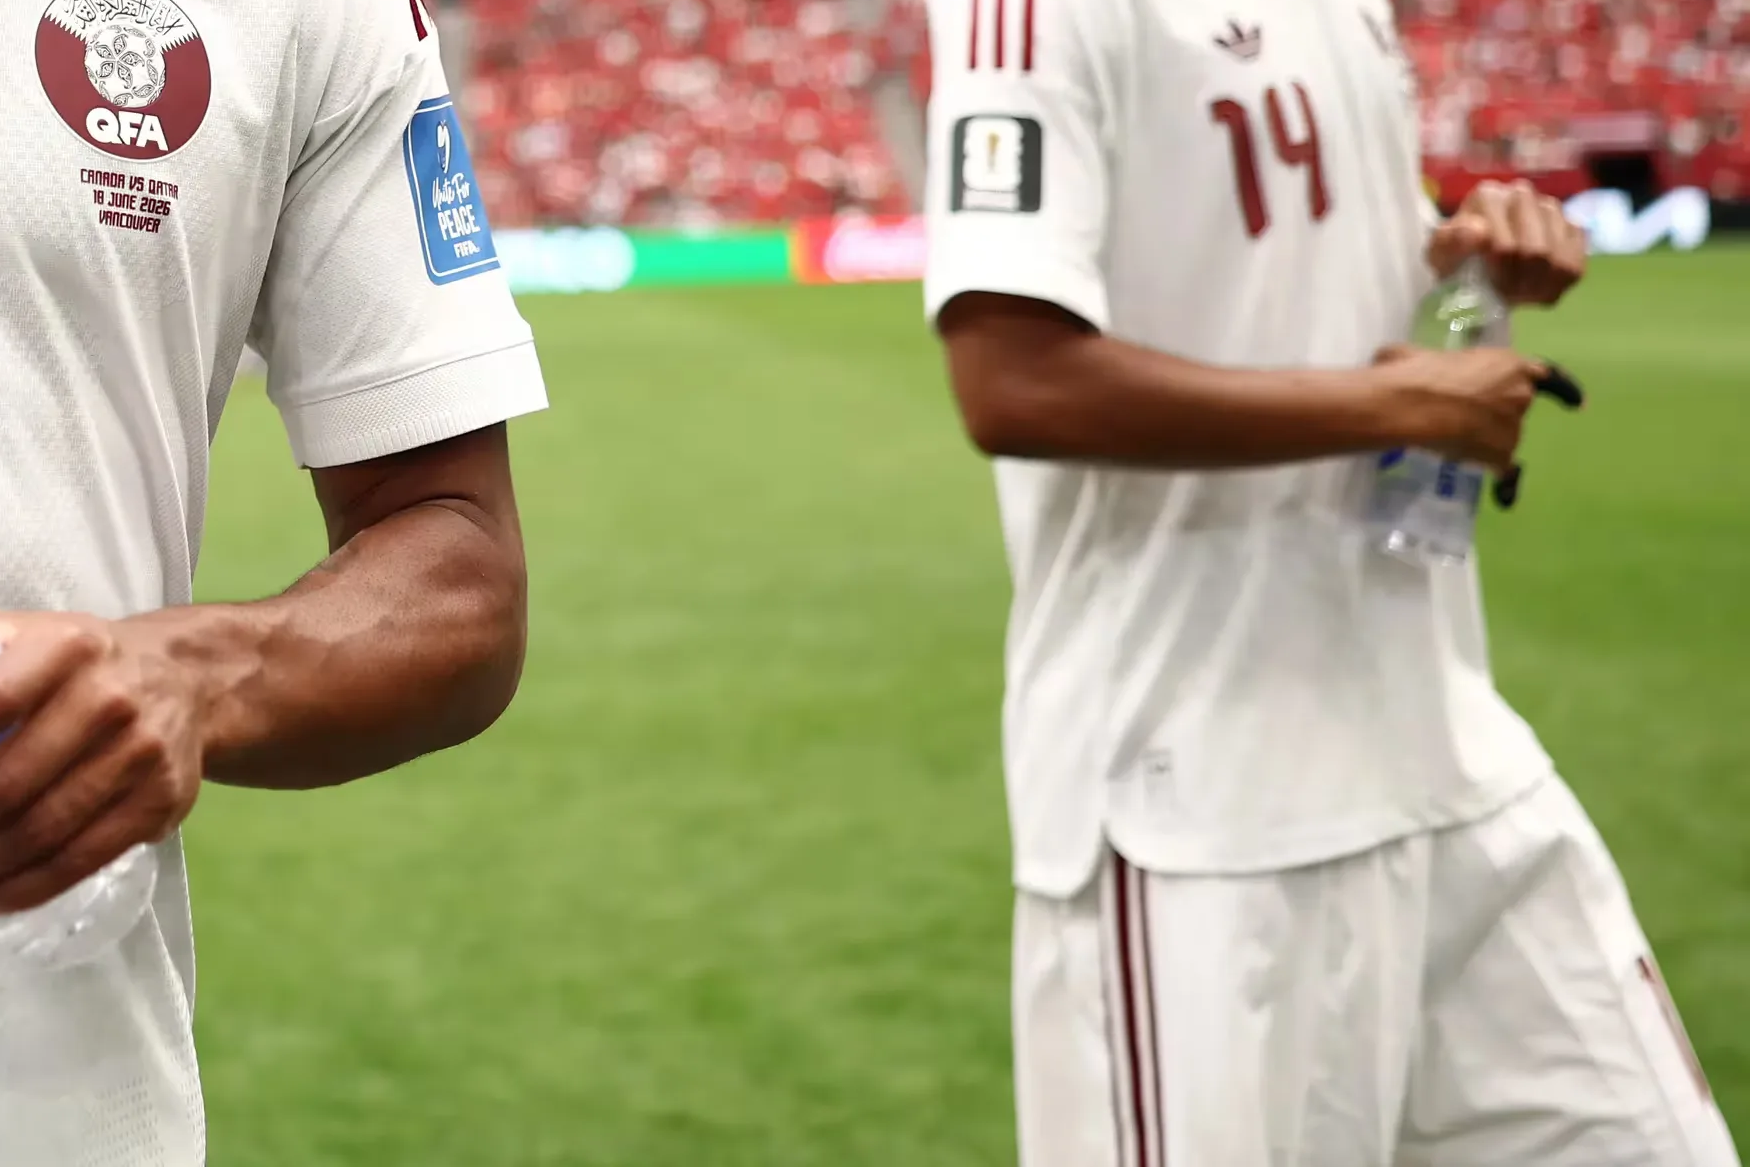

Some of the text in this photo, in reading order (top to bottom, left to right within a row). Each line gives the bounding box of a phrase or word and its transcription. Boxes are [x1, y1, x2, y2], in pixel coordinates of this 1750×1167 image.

[86, 107, 169, 152] QFA
[1211, 82, 1333, 239] 14
[80, 168, 179, 201] CANADA VS QATAR
[93, 189, 171, 217] 18 JUNE 2026
[98, 209, 162, 234] VANCOUVER
